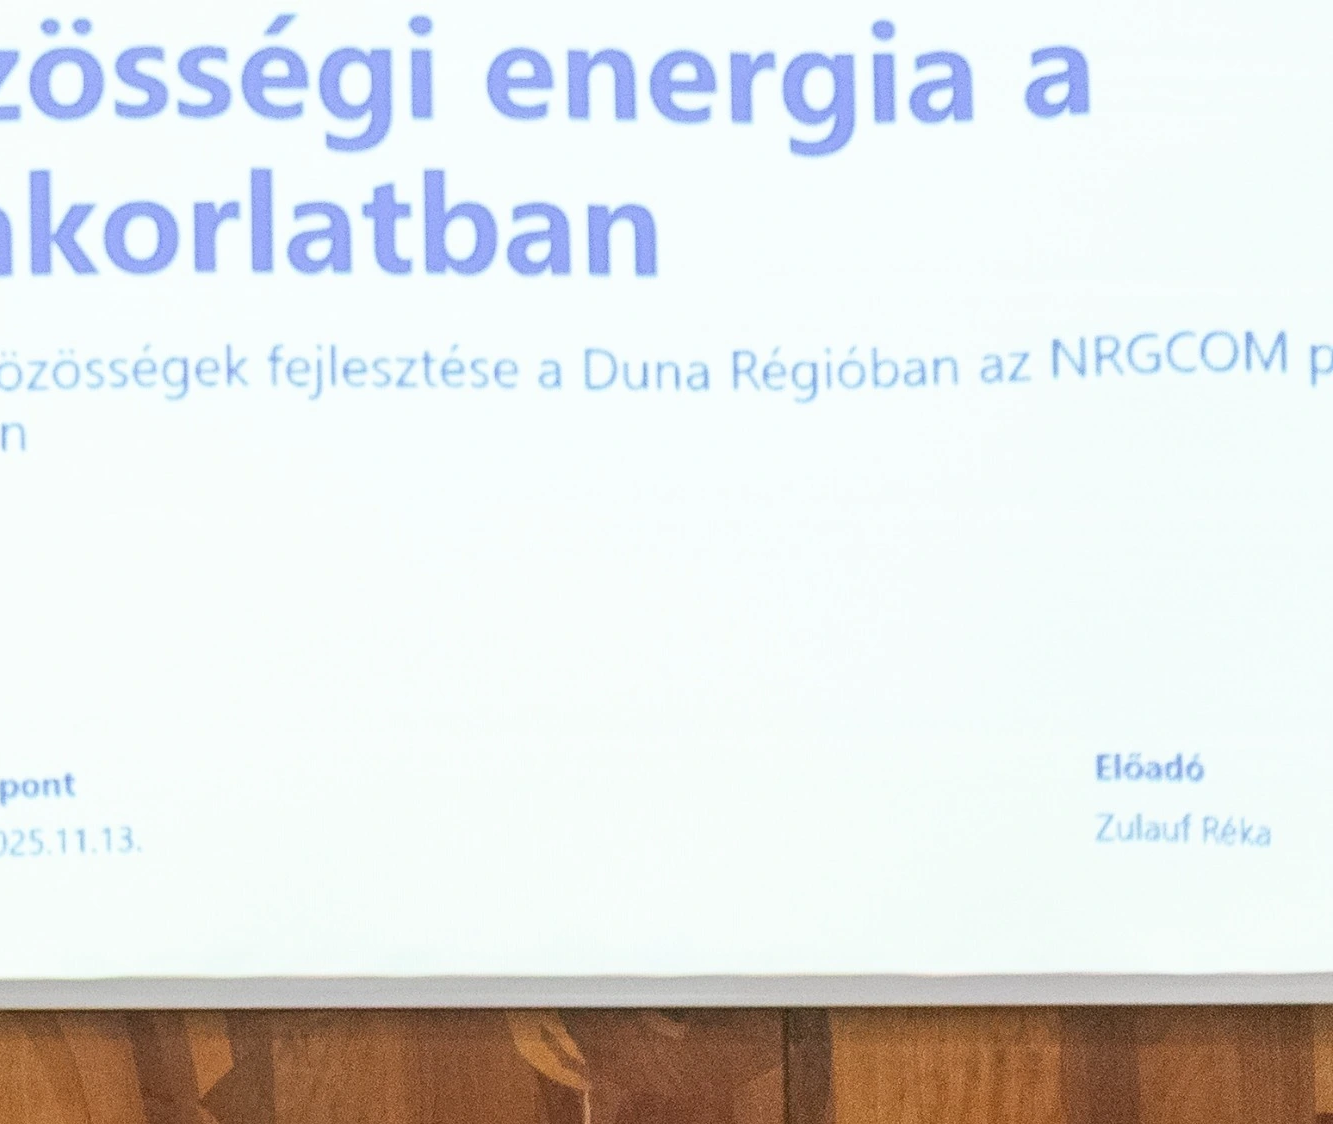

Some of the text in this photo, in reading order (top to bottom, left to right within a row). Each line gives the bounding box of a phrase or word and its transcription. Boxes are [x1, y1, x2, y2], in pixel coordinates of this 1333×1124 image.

[485, 18, 976, 159] energia
[1023, 44, 1093, 122] a
[267, 342, 521, 404] fejlesztése
[537, 358, 564, 393] a
[583, 346, 712, 393] Duna
[732, 344, 961, 403] Régióban
[979, 350, 1032, 384] az
[1051, 328, 1289, 381] NRGCOM
[1096, 752, 1206, 783] Előadó
[1095, 812, 1272, 847] Zulauf Réka
